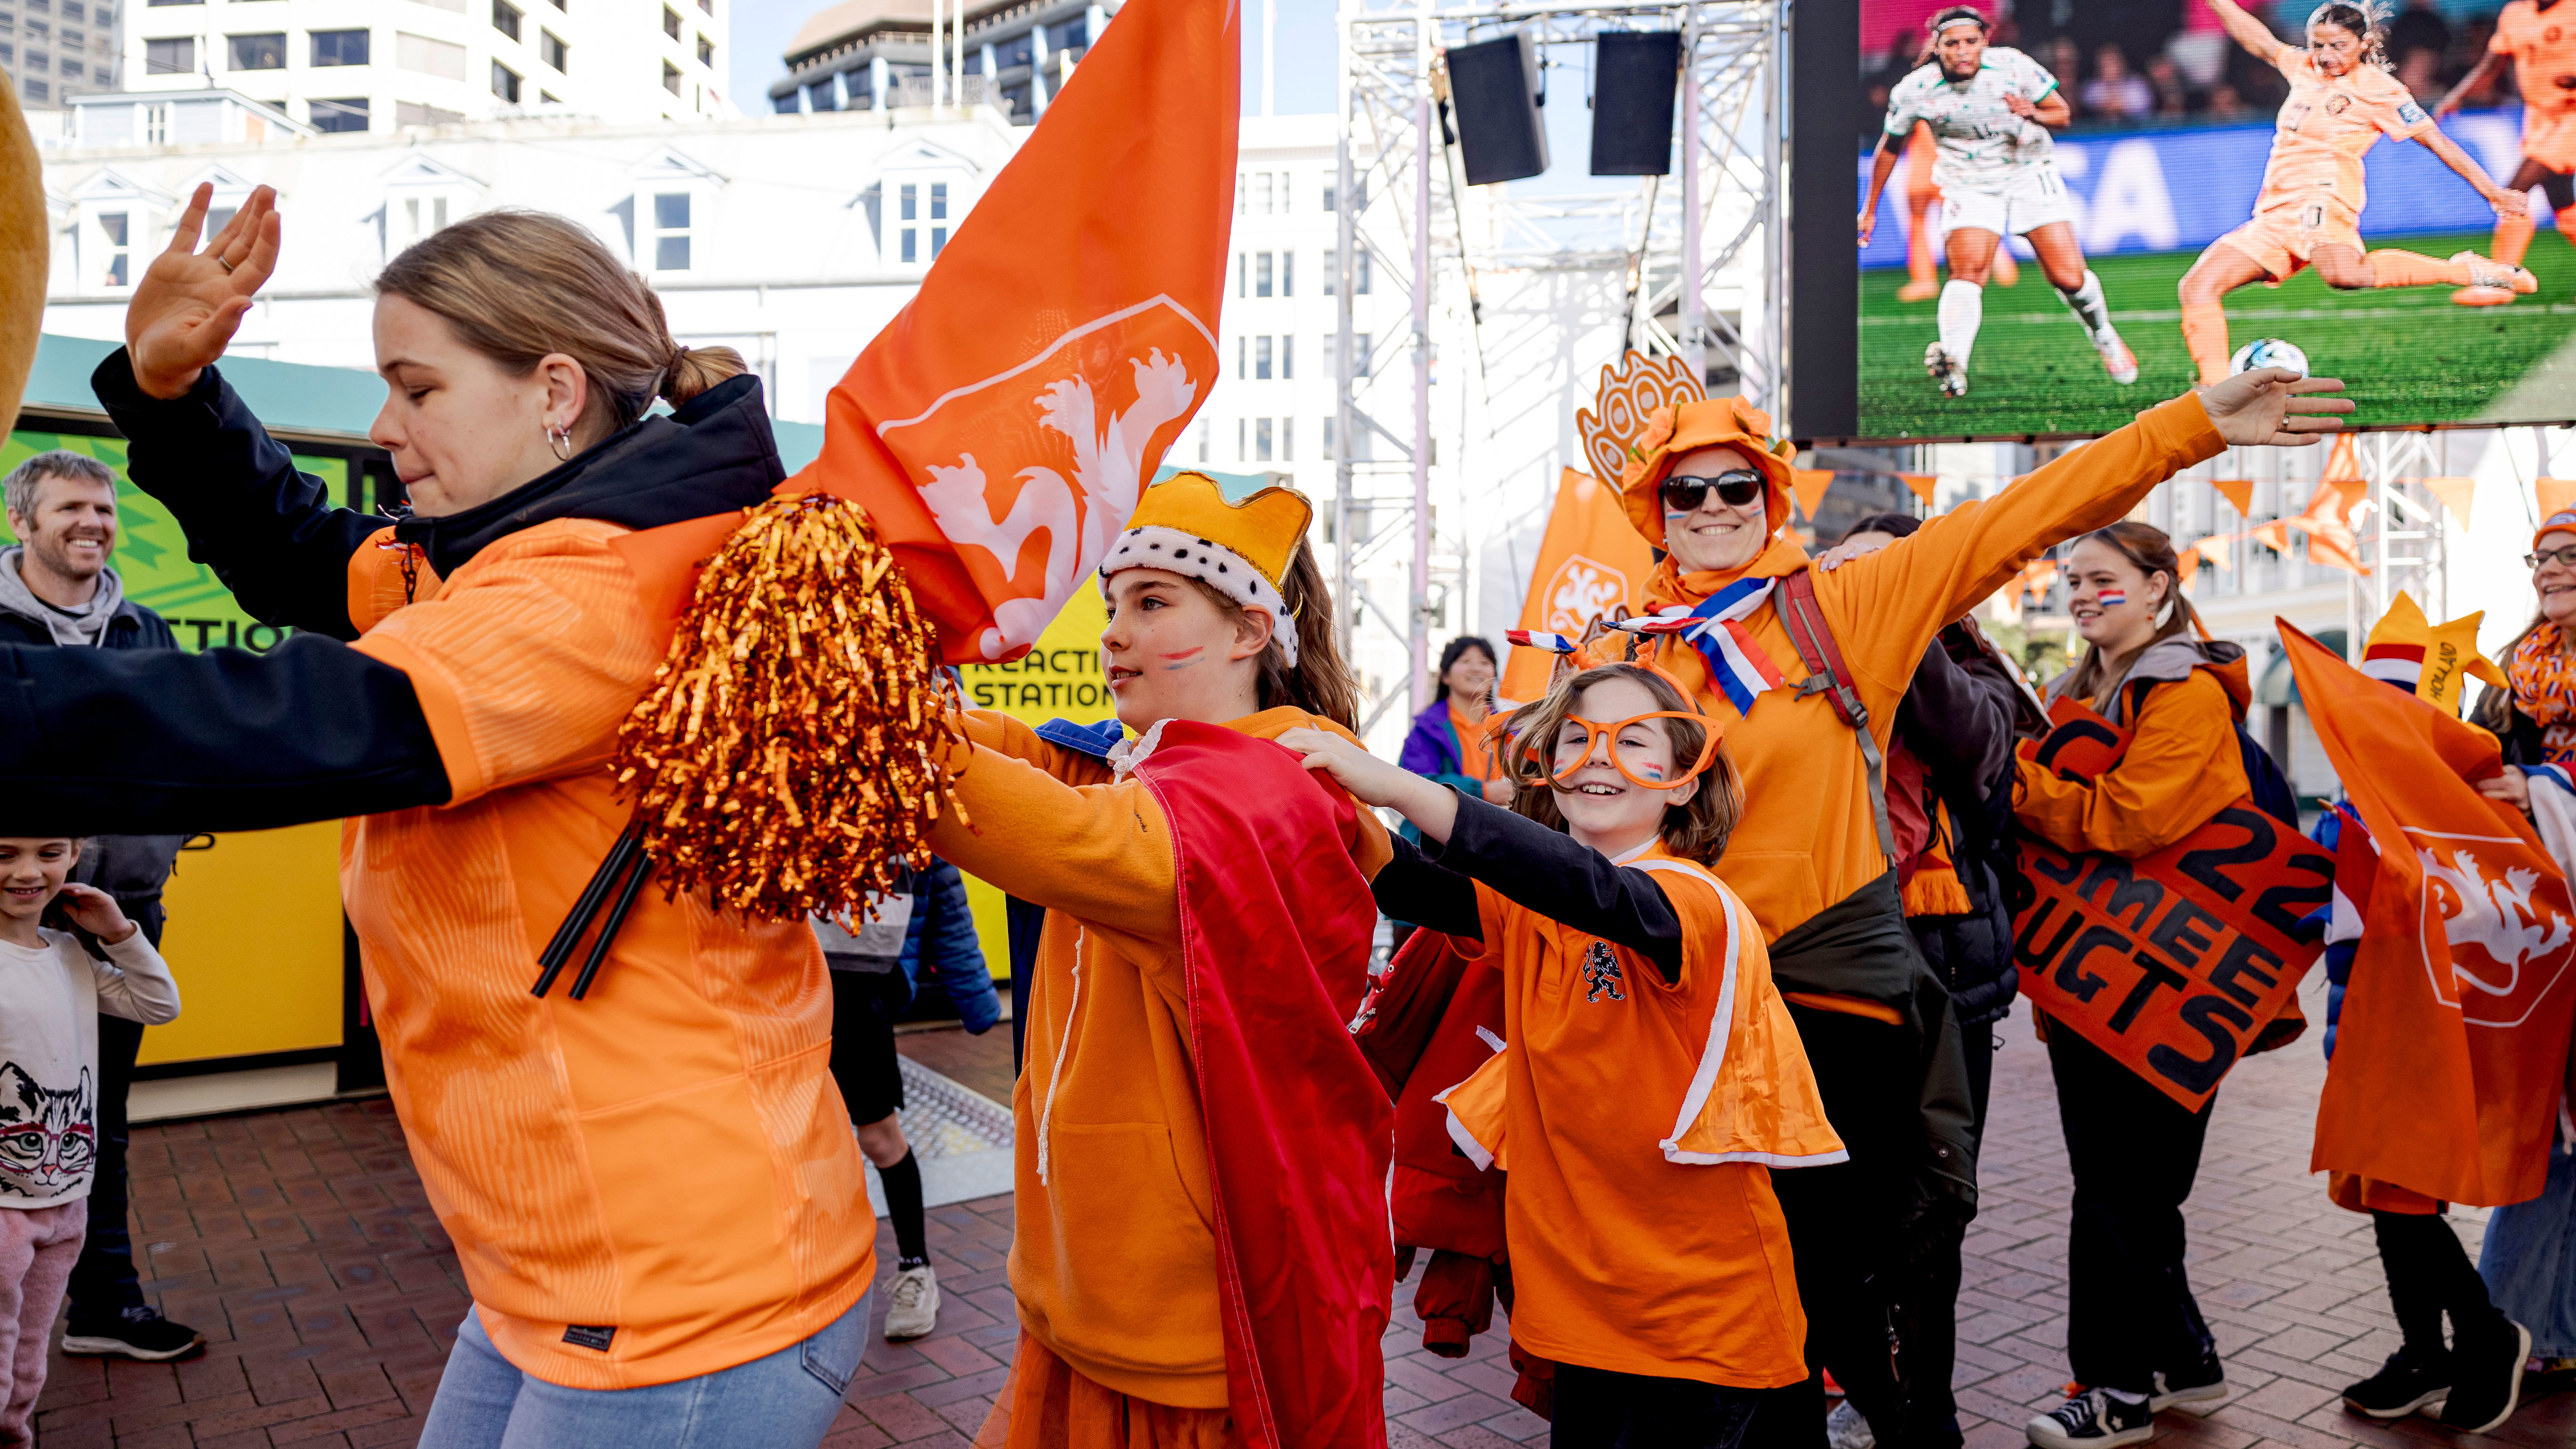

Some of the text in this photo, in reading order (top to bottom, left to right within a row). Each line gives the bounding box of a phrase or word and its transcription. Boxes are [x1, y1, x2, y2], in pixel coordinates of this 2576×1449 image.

[165, 619, 308, 653] TIO
[2430, 641, 2456, 702] HOLLAND
[2024, 852, 2285, 1009] SMEE
